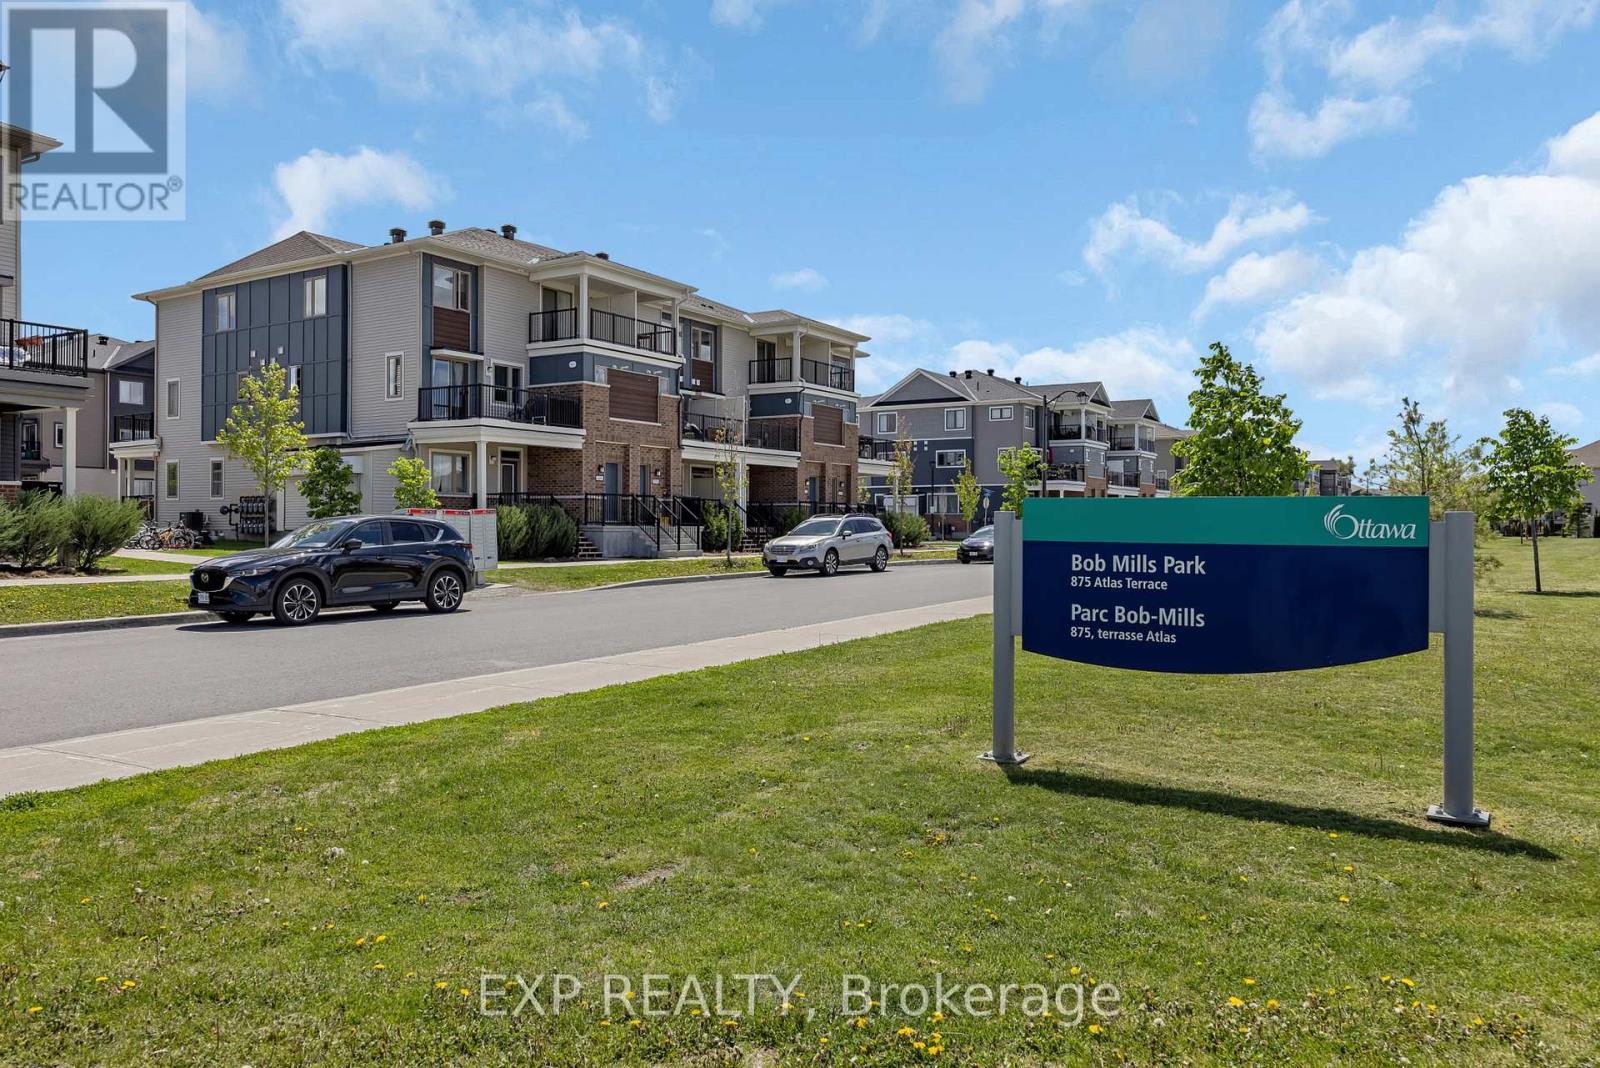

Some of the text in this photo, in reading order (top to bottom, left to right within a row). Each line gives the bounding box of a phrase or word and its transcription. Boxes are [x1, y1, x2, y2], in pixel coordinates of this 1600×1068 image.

[1330, 510, 1417, 540] Ottawa
[1071, 553, 1206, 575] Bob Mills Park
[1070, 576, 1168, 590] 875 Atlas Terrace
[1071, 603, 1205, 627] Parc Bob-Mills
[1070, 626, 1176, 643] 875, terrasse Atlas
